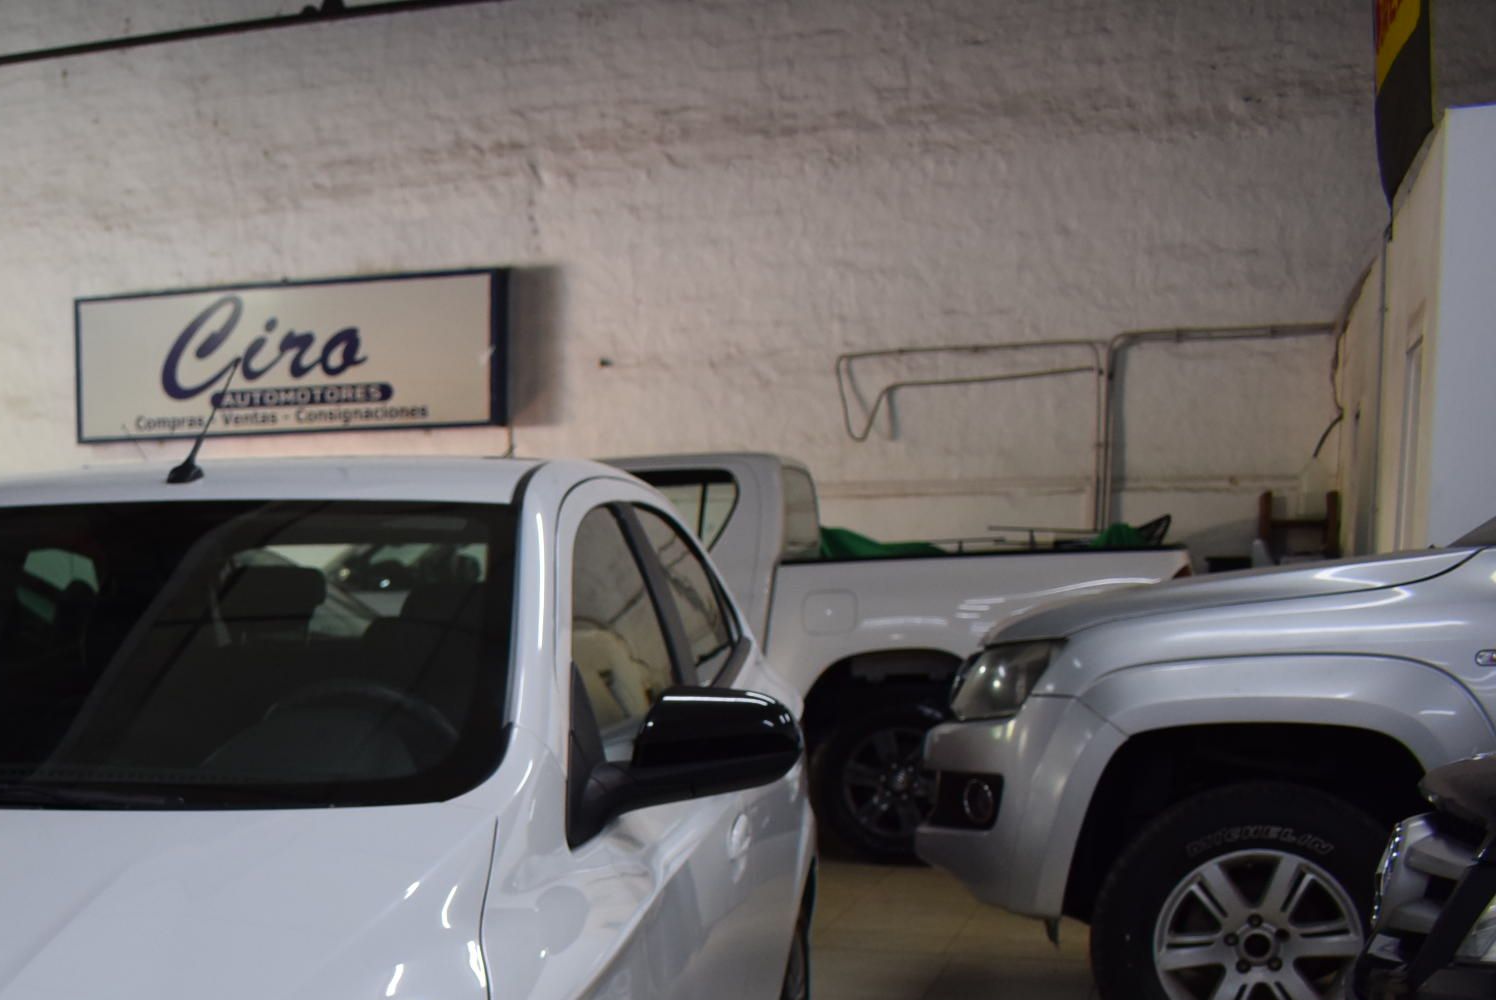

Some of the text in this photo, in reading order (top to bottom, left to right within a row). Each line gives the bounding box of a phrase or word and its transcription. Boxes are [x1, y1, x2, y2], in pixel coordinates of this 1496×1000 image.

[161, 296, 369, 400] Ciro
[221, 384, 382, 407] AUTOMOTORES
[135, 413, 204, 432] Compras
[222, 411, 278, 426] Ventas
[295, 403, 429, 426] Consignaciones
[1184, 824, 1335, 857] MICHELIN
